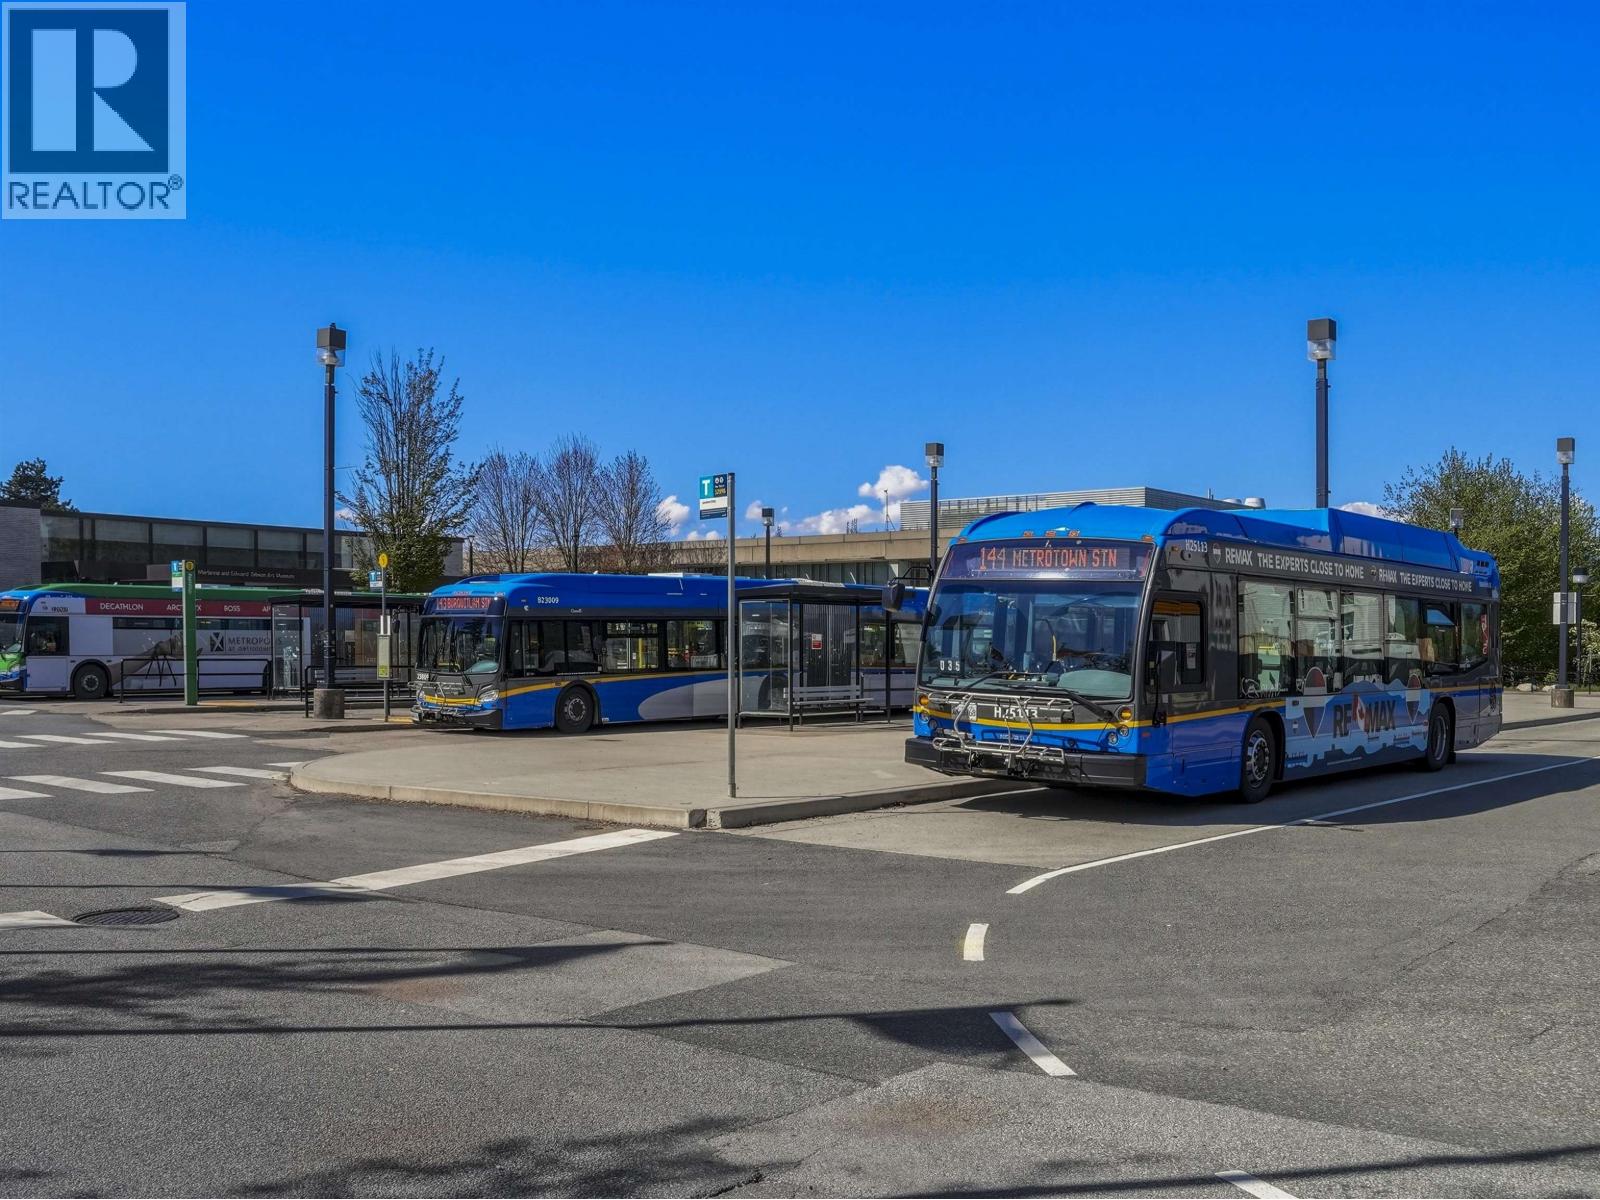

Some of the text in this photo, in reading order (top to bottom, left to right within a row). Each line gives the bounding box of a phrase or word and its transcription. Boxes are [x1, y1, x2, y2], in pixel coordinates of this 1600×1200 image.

[980, 547, 1117, 571] 144 METROTOWN STN
[1257, 552, 1274, 569] THE
[1275, 554, 1309, 573] EXPERTS
[1310, 561, 1334, 576] CLOSE
[1334, 563, 1344, 577] TO
[1345, 564, 1365, 579] HOME
[1400, 571, 1411, 585] THE
[1412, 574, 1435, 588] EXPERTS
[1435, 578, 1451, 590] CLOSE
[1451, 579, 1458, 590] TO
[99, 602, 144, 611] DECATHLON
